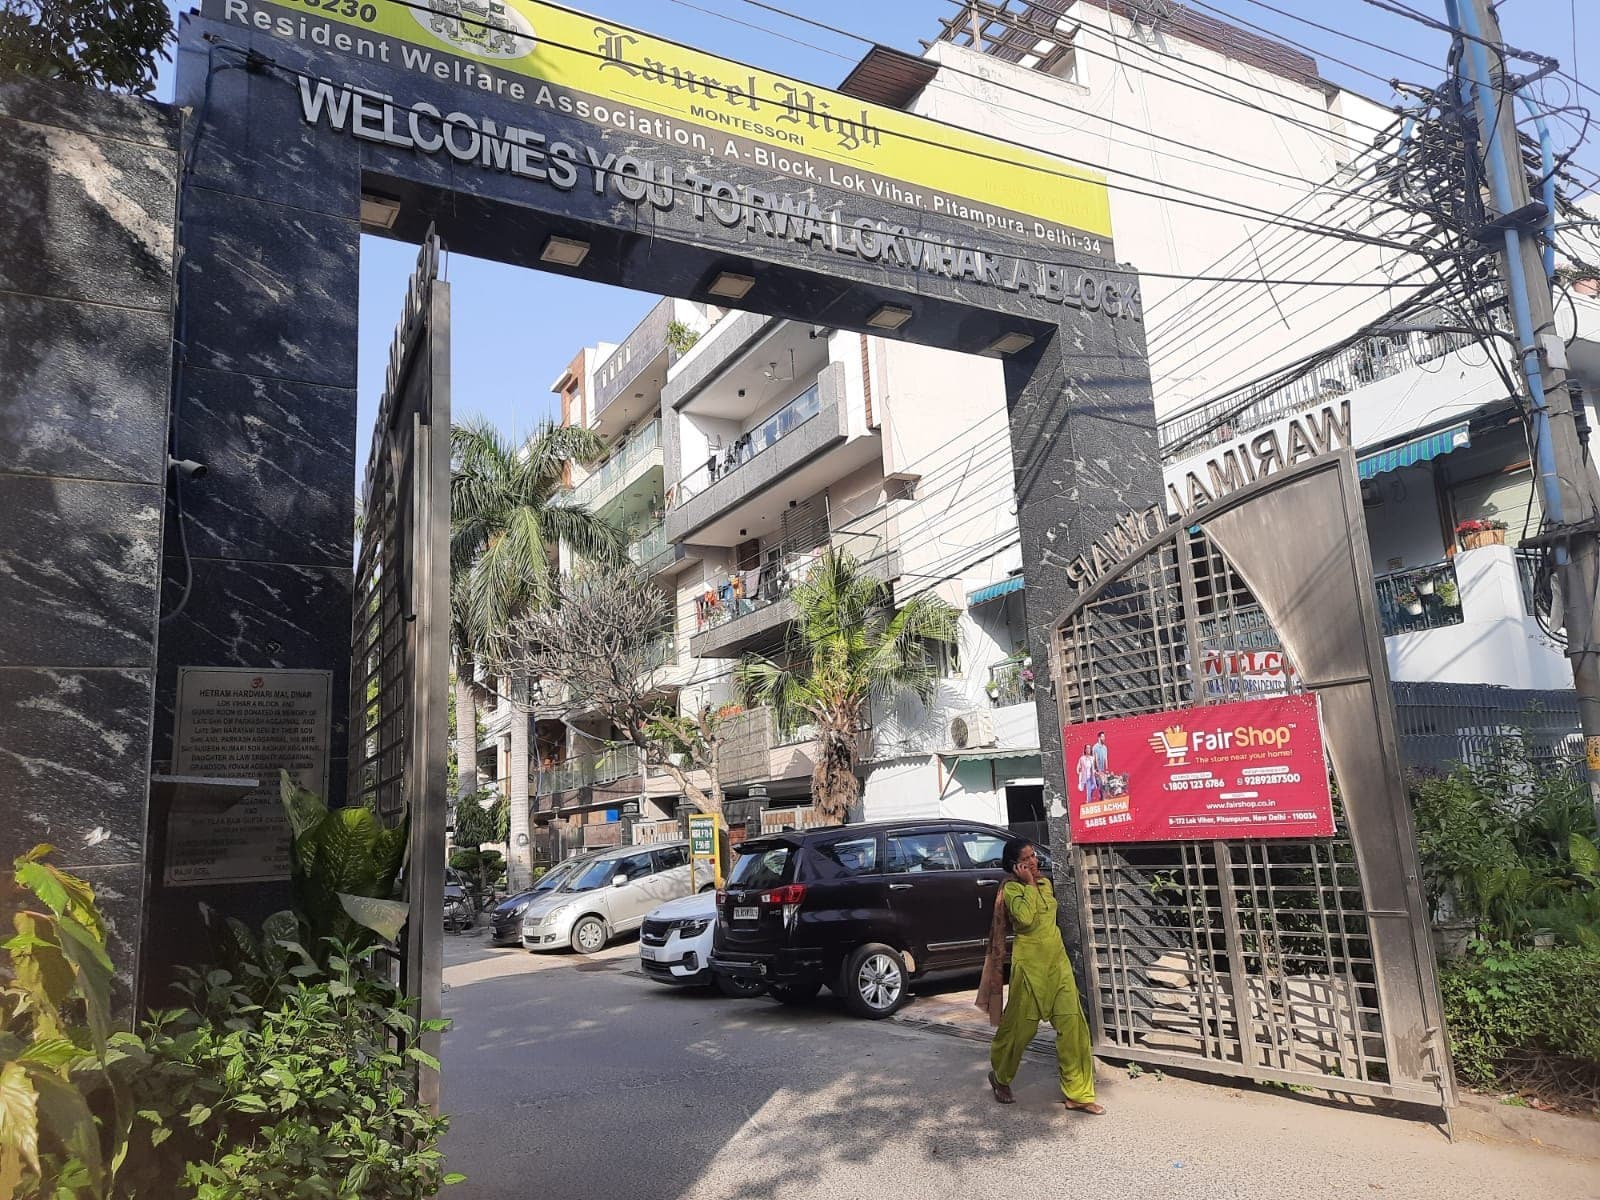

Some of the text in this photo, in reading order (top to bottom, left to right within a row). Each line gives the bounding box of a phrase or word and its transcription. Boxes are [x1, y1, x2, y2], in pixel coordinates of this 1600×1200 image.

[593, 26, 881, 151] Laurel High
[225, 0, 389, 63] Resident
[402, 47, 525, 99] Welfare
[535, 86, 714, 156] Association,
[829, 168, 866, 193] Lok
[934, 195, 1029, 237] Pitampura,
[1035, 223, 1101, 254] Delhi-34
[690, 104, 805, 147] MONTESSORI
[298, 75, 578, 192] WELCOMES
[586, 146, 675, 212] YOU
[684, 171, 742, 228] TO
[742, 187, 831, 250] RWA
[831, 207, 907, 268] LOK
[900, 226, 1000, 288] VIHAR
[1195, 756, 1209, 764] The
[1210, 755, 1230, 763] store
[1248, 752, 1266, 761] your
[1267, 749, 1293, 758] home!
[1169, 779, 1225, 791] 1800 123 6786
[1206, 800, 1276, 810] www.fairshop.co.in
[1085, 812, 1132, 828] SABSE SASTA
[1252, 814, 1268, 822] New
